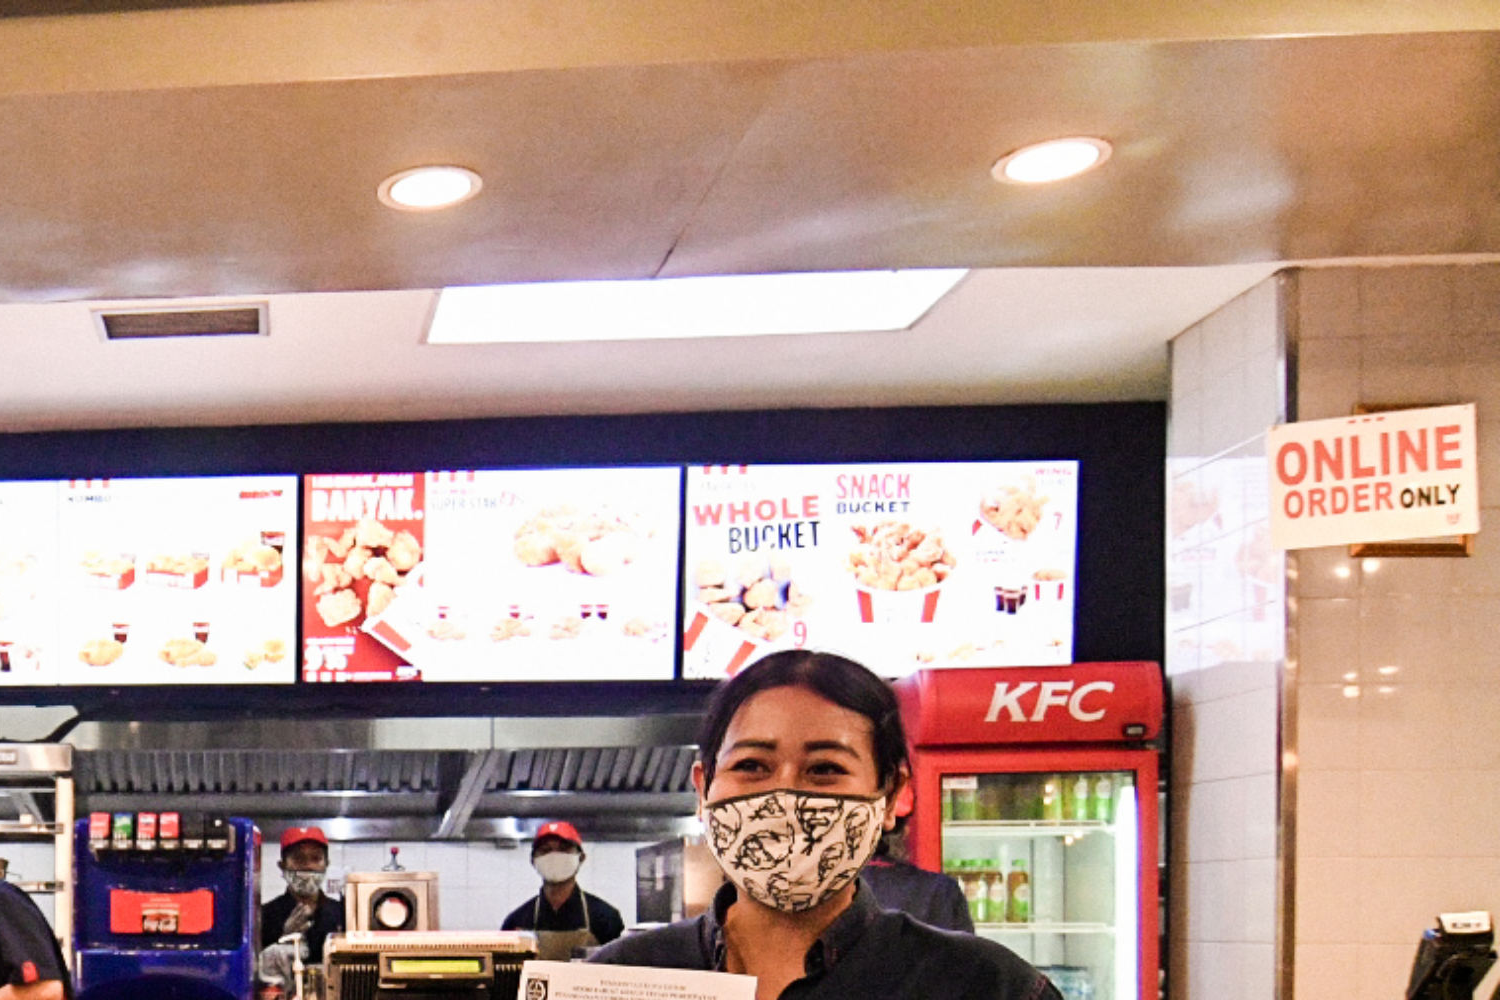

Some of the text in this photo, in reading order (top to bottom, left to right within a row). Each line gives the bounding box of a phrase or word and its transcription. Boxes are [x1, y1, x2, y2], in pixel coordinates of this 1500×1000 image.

[1276, 424, 1463, 486] ONLINE
[836, 473, 911, 500] SNACK
[1284, 482, 1460, 519] ORDER ONLY
[693, 495, 820, 527] WHOLE
[837, 501, 911, 514] BUCKET
[729, 521, 821, 554] BUCKET
[984, 680, 1116, 723] KFC
